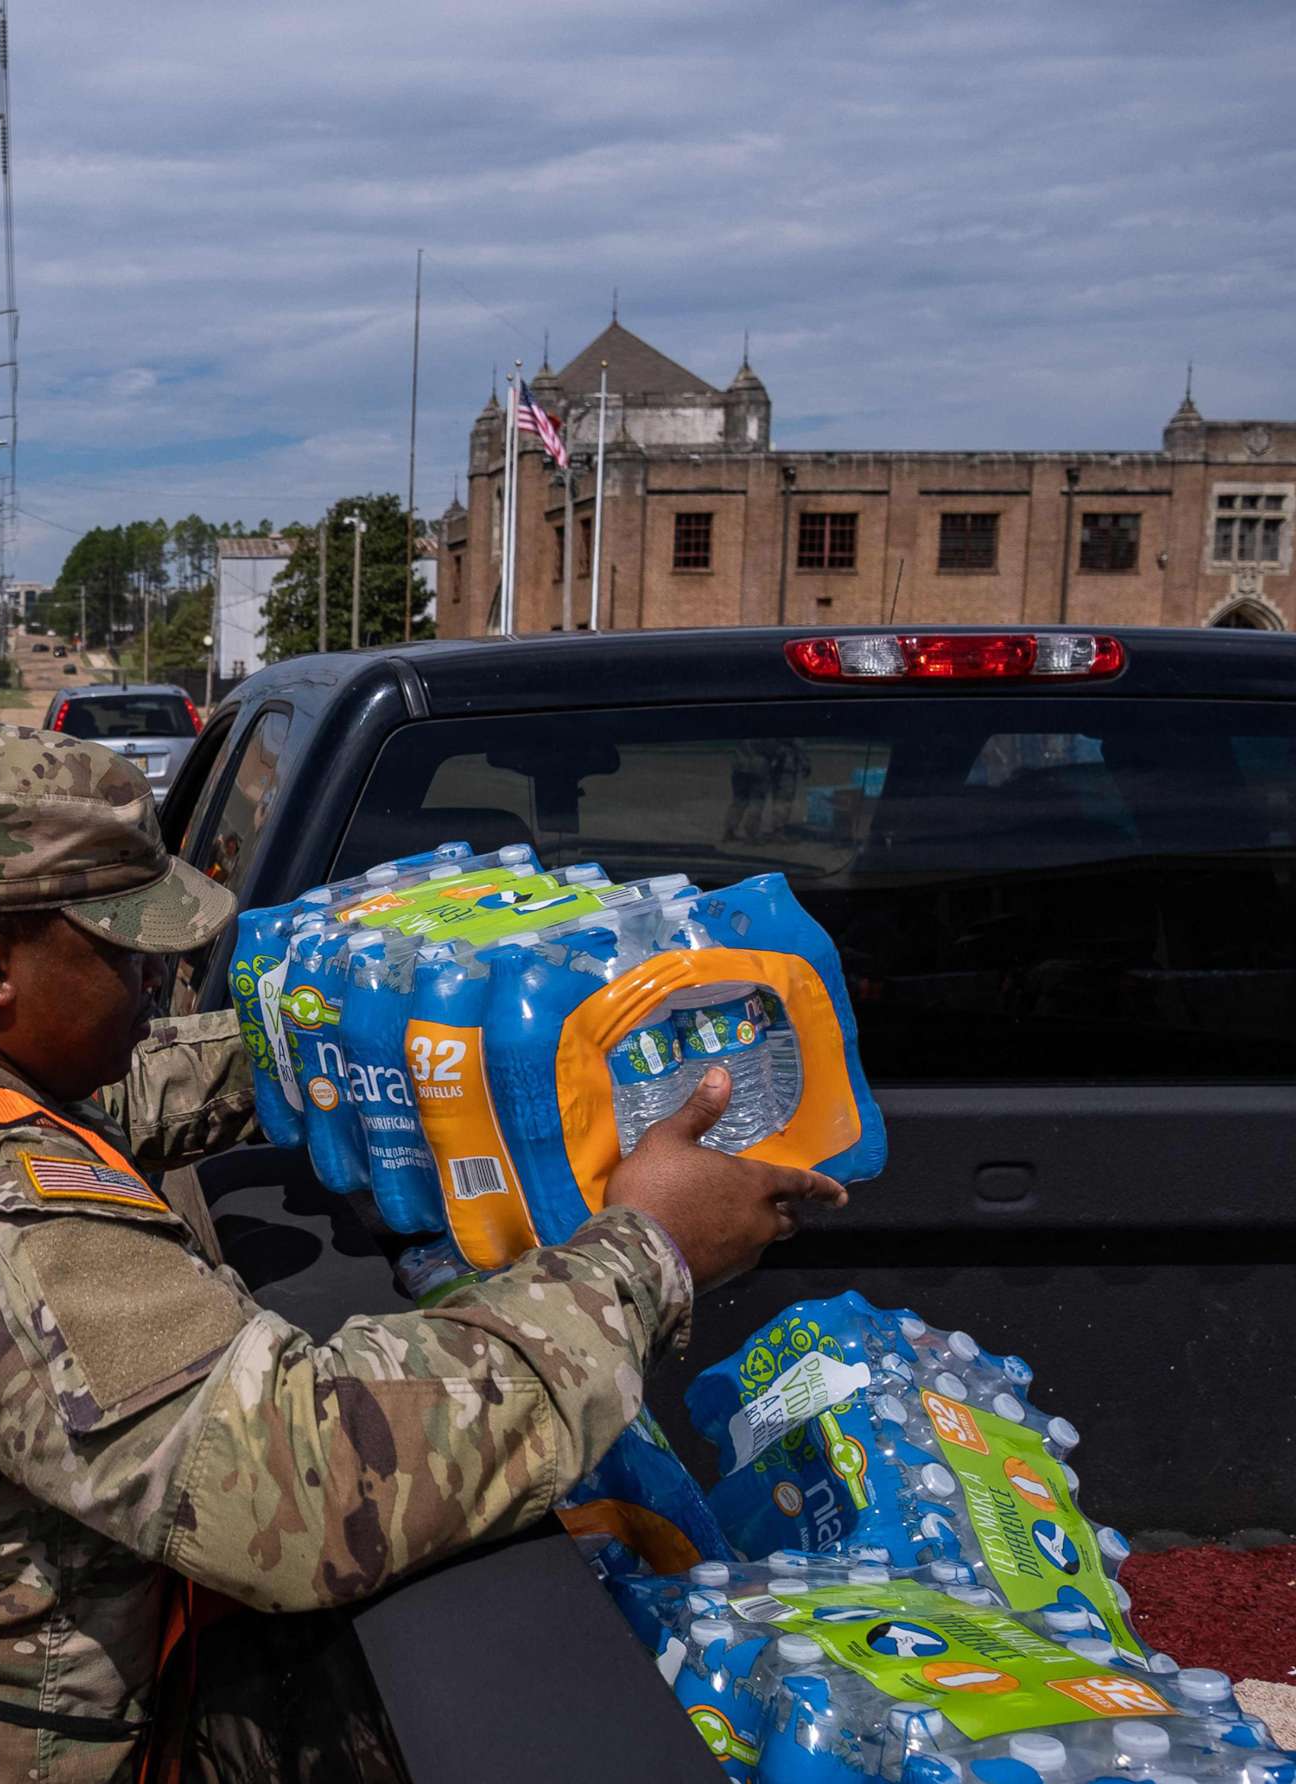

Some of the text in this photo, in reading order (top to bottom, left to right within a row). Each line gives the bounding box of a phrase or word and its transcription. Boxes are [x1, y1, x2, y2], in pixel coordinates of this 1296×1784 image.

[409, 1035, 467, 1082] 32
[418, 1085, 464, 1099] BOTELLAS
[364, 1115, 416, 1131] PURIFICADA
[760, 1394, 780, 1411] A
[927, 1396, 968, 1442] 32
[959, 1470, 985, 1485] A
[965, 1484, 1001, 1533] MAKE
[989, 1486, 1044, 1579] DIFFERENCE
[983, 1533, 1019, 1576] LET'S
[1087, 1678, 1168, 1712] 32
